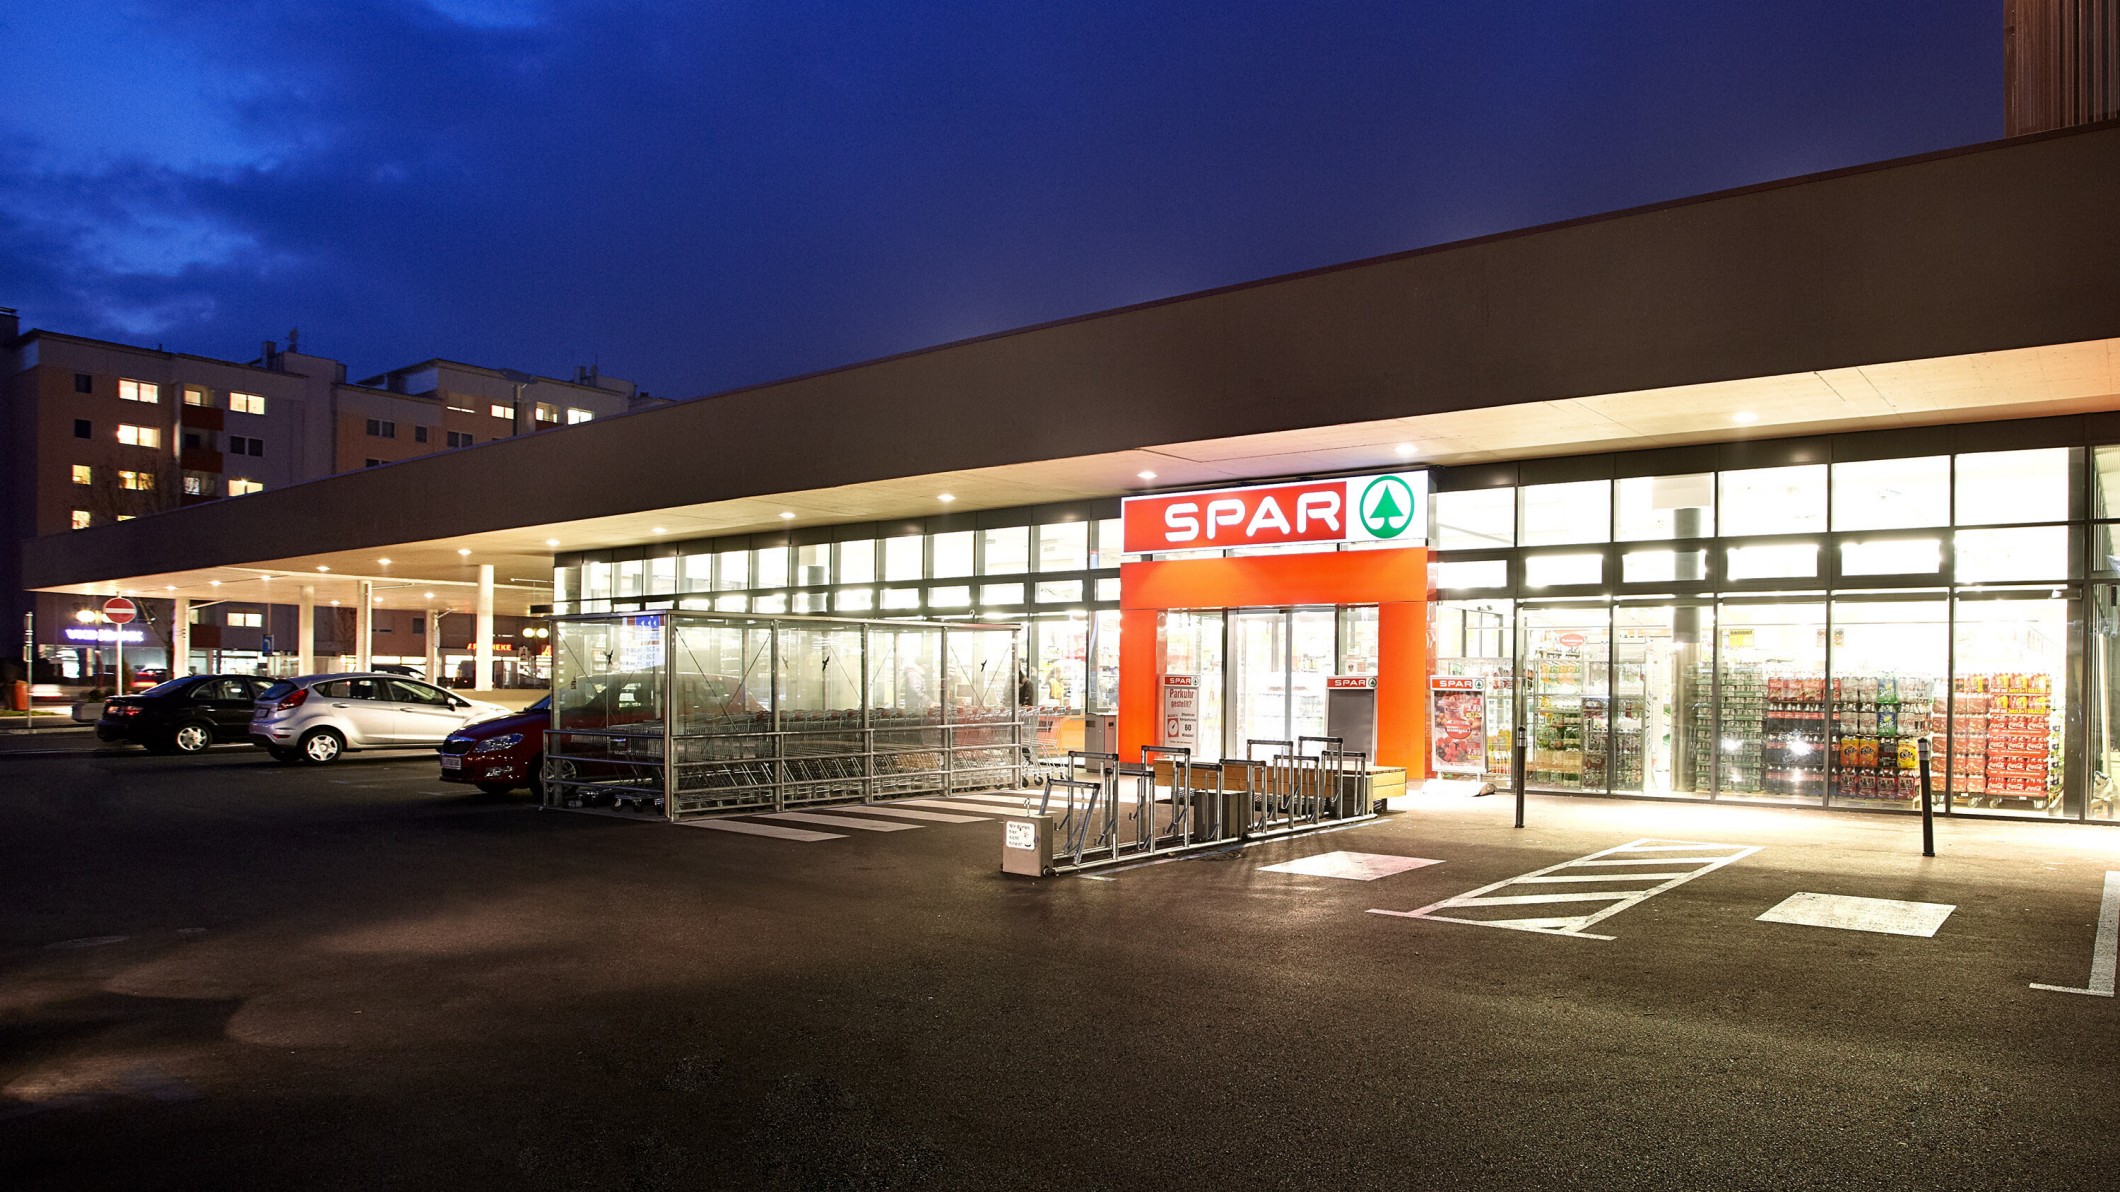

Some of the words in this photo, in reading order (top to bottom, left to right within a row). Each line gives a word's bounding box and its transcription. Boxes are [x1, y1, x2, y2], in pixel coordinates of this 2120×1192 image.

[1164, 490, 1341, 542] SPAR
[1440, 680, 1472, 688] SPAR
[1169, 688, 1194, 699] Parkuhr
